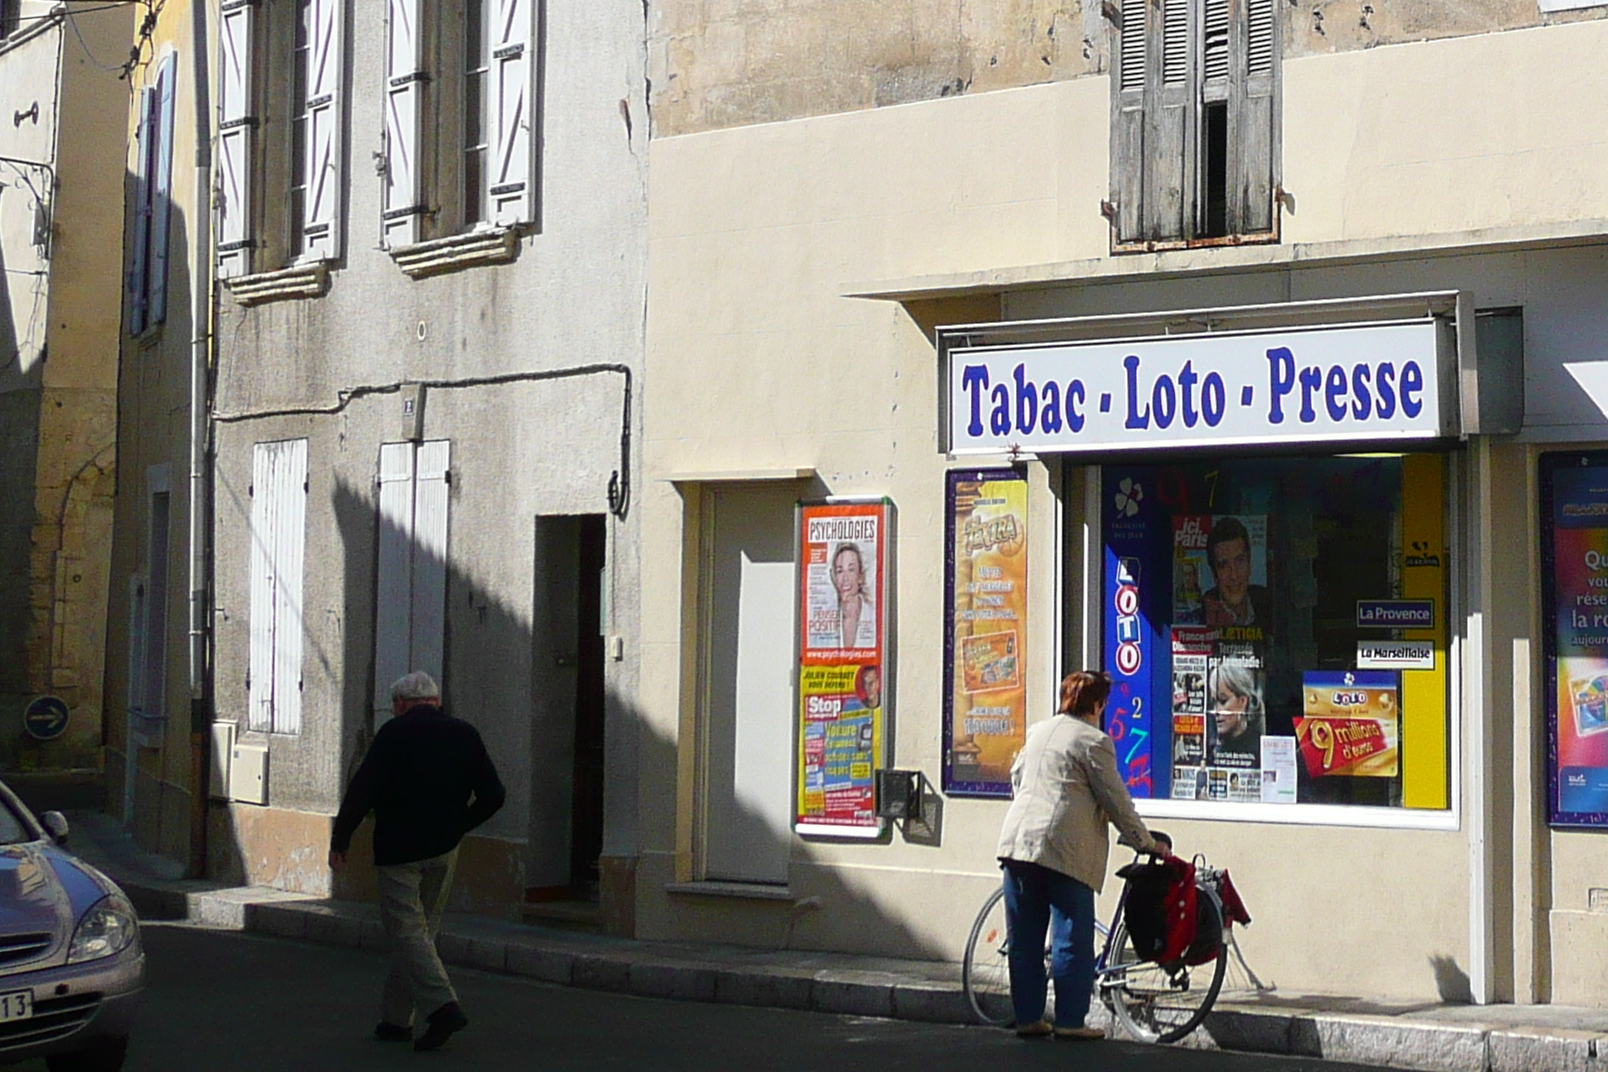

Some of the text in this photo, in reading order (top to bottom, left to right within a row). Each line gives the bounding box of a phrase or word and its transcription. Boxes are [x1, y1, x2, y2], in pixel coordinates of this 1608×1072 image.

[961, 362, 1086, 437] Tabac
[1124, 354, 1226, 430] Loto
[1265, 346, 1424, 424] Presse
[810, 519, 875, 541] PSYCHOLOGIES
[1116, 558, 1140, 673] LOTO
[1359, 606, 1430, 620] La Provence
[1572, 610, 1588, 628] la
[1172, 640, 1212, 652] Dimanche
[1178, 630, 1206, 643] France
[1361, 647, 1431, 659] La Marseillaise
[808, 696, 841, 717] Stop
[1132, 697, 1142, 718] 2
[1332, 691, 1368, 706] LOTO
[1124, 728, 1148, 764] 7
[1310, 719, 1380, 769] 9 millions
[2, 994, 26, 1018] 13
